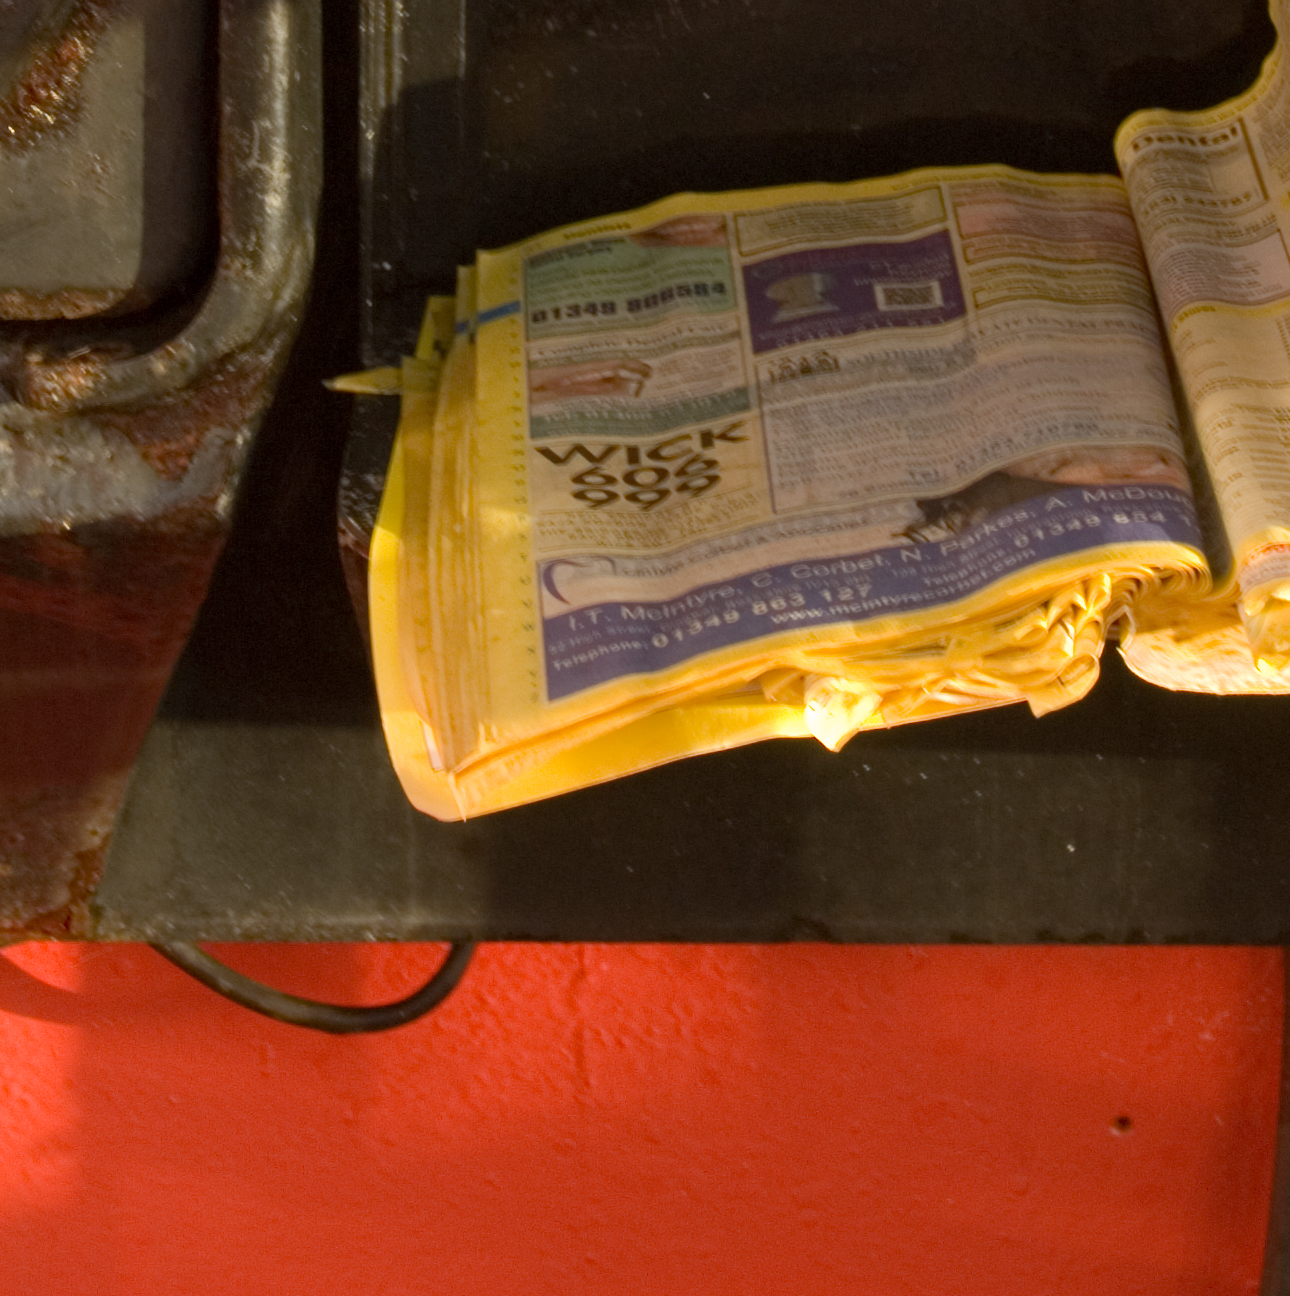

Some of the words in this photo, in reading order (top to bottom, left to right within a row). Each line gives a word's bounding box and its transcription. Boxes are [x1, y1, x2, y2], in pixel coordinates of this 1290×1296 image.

[1131, 124, 1239, 152] Dental
[535, 420, 750, 466] WICK
[571, 454, 720, 488] 606
[899, 546, 932, 564] N.
[939, 508, 1037, 557] Parkes,
[1043, 495, 1074, 513] A.
[1013, 515, 1101, 550] 01349
[650, 608, 740, 648] 01349
[751, 591, 806, 616] 863
[818, 583, 873, 603] 127
